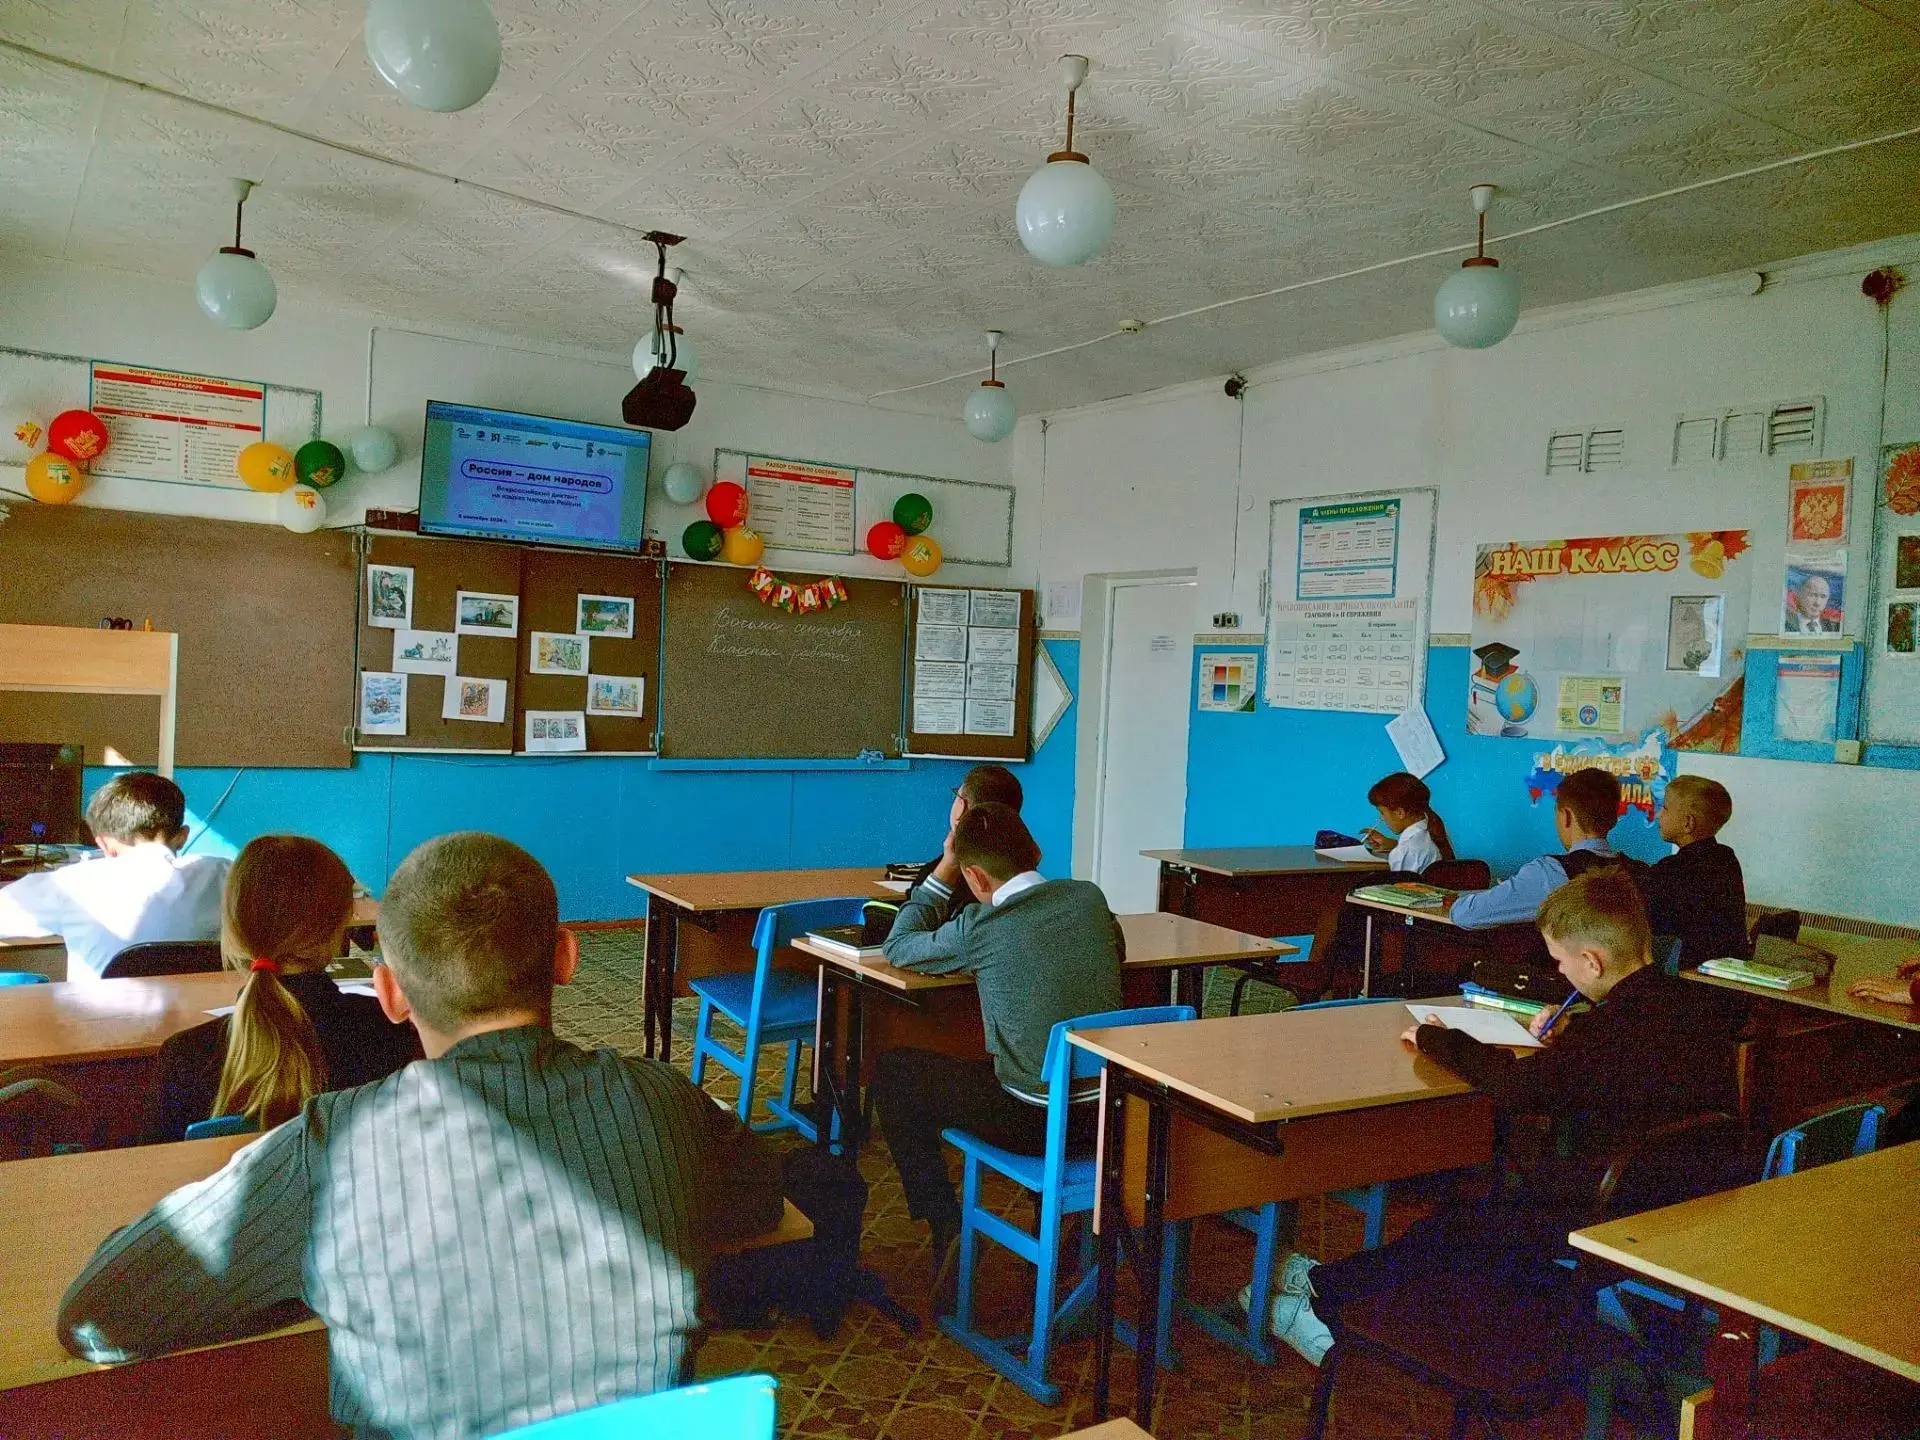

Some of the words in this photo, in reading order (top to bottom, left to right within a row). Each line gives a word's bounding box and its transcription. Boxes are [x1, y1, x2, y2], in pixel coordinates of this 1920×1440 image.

[181, 375, 206, 383] РАЗБОР
[766, 461, 787, 469] РАЗБОР
[469, 463, 512, 477] Россия
[527, 472, 551, 483] дом
[554, 475, 602, 489] народов
[496, 485, 550, 497] Всероссийский
[1339, 504, 1385, 514] ПРЕДЛОЖЕНИЯ
[1491, 548, 1563, 576] НАШ
[1569, 543, 1681, 574] КЛАСС
[1621, 783, 1652, 804] ИЛА
